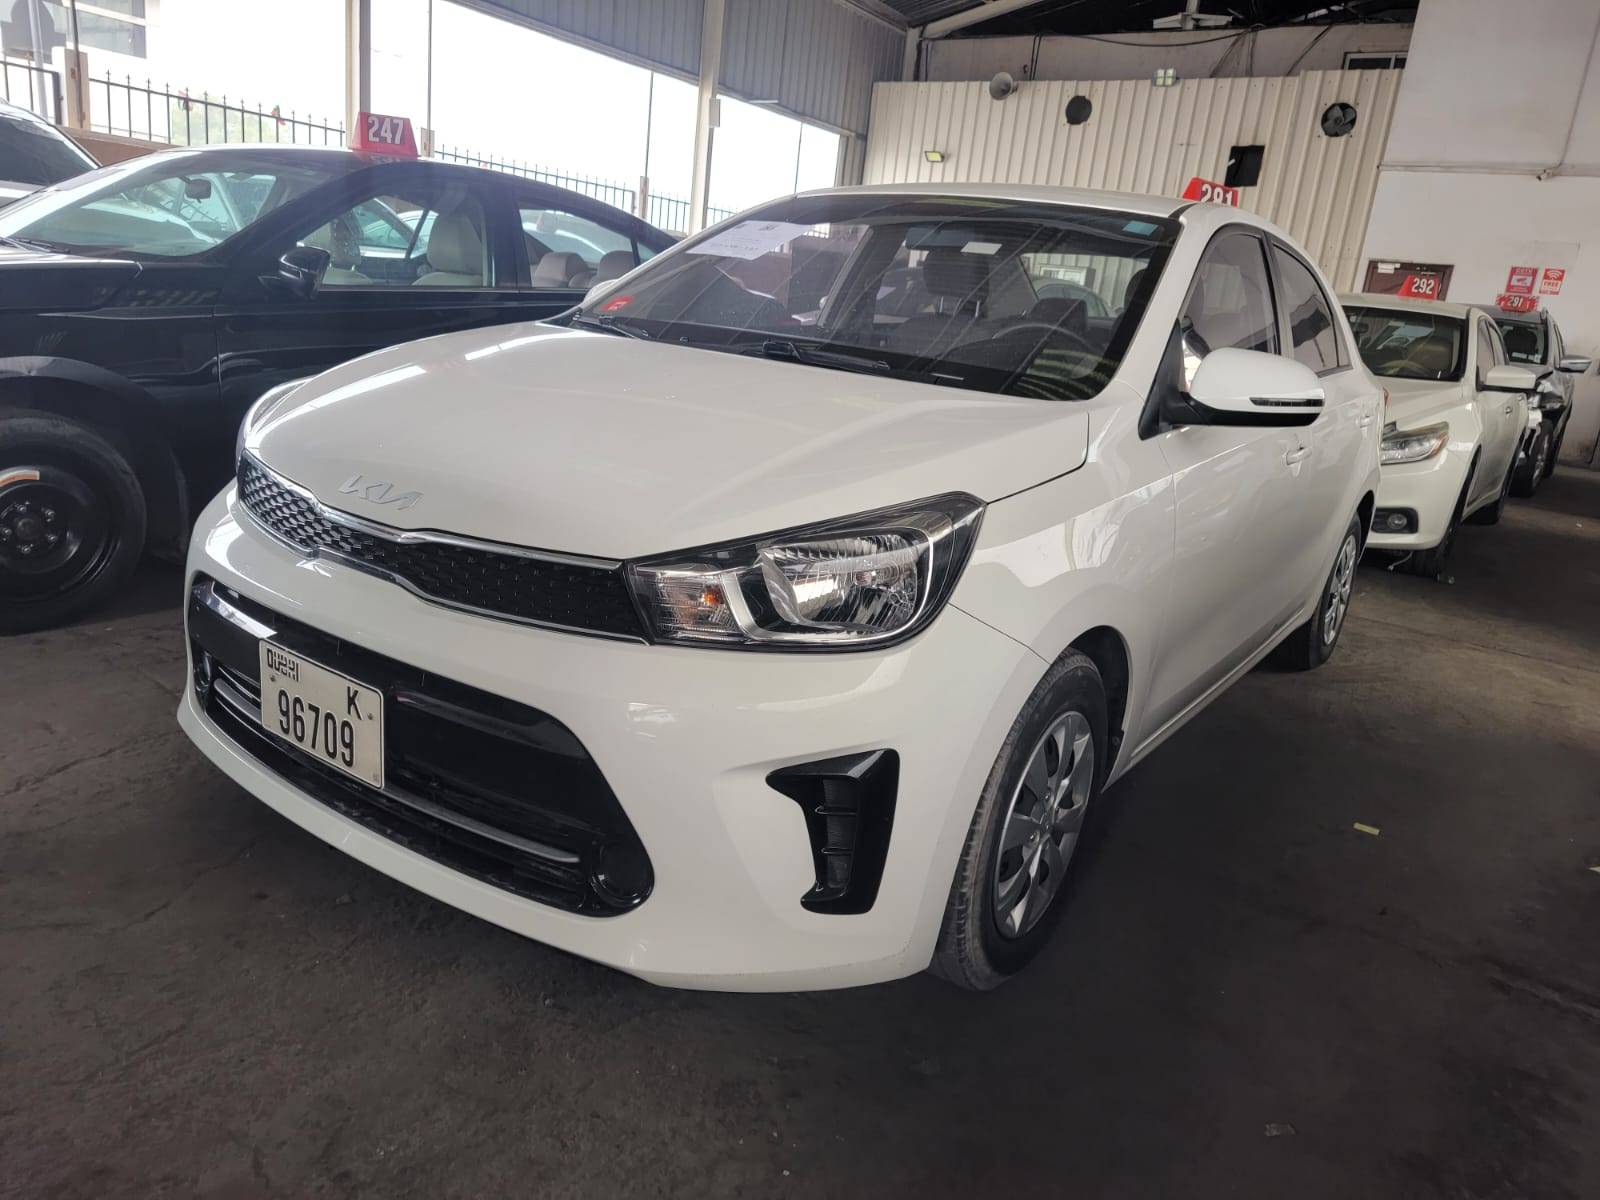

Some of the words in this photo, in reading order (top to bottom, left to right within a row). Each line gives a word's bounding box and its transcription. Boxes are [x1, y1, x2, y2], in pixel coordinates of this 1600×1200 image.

[368, 115, 404, 145] 247
[1411, 277, 1435, 295] 292
[338, 473, 423, 511] KIA
[266, 647, 299, 682] DUBAI
[347, 686, 362, 721] K
[278, 689, 354, 768] 96709
